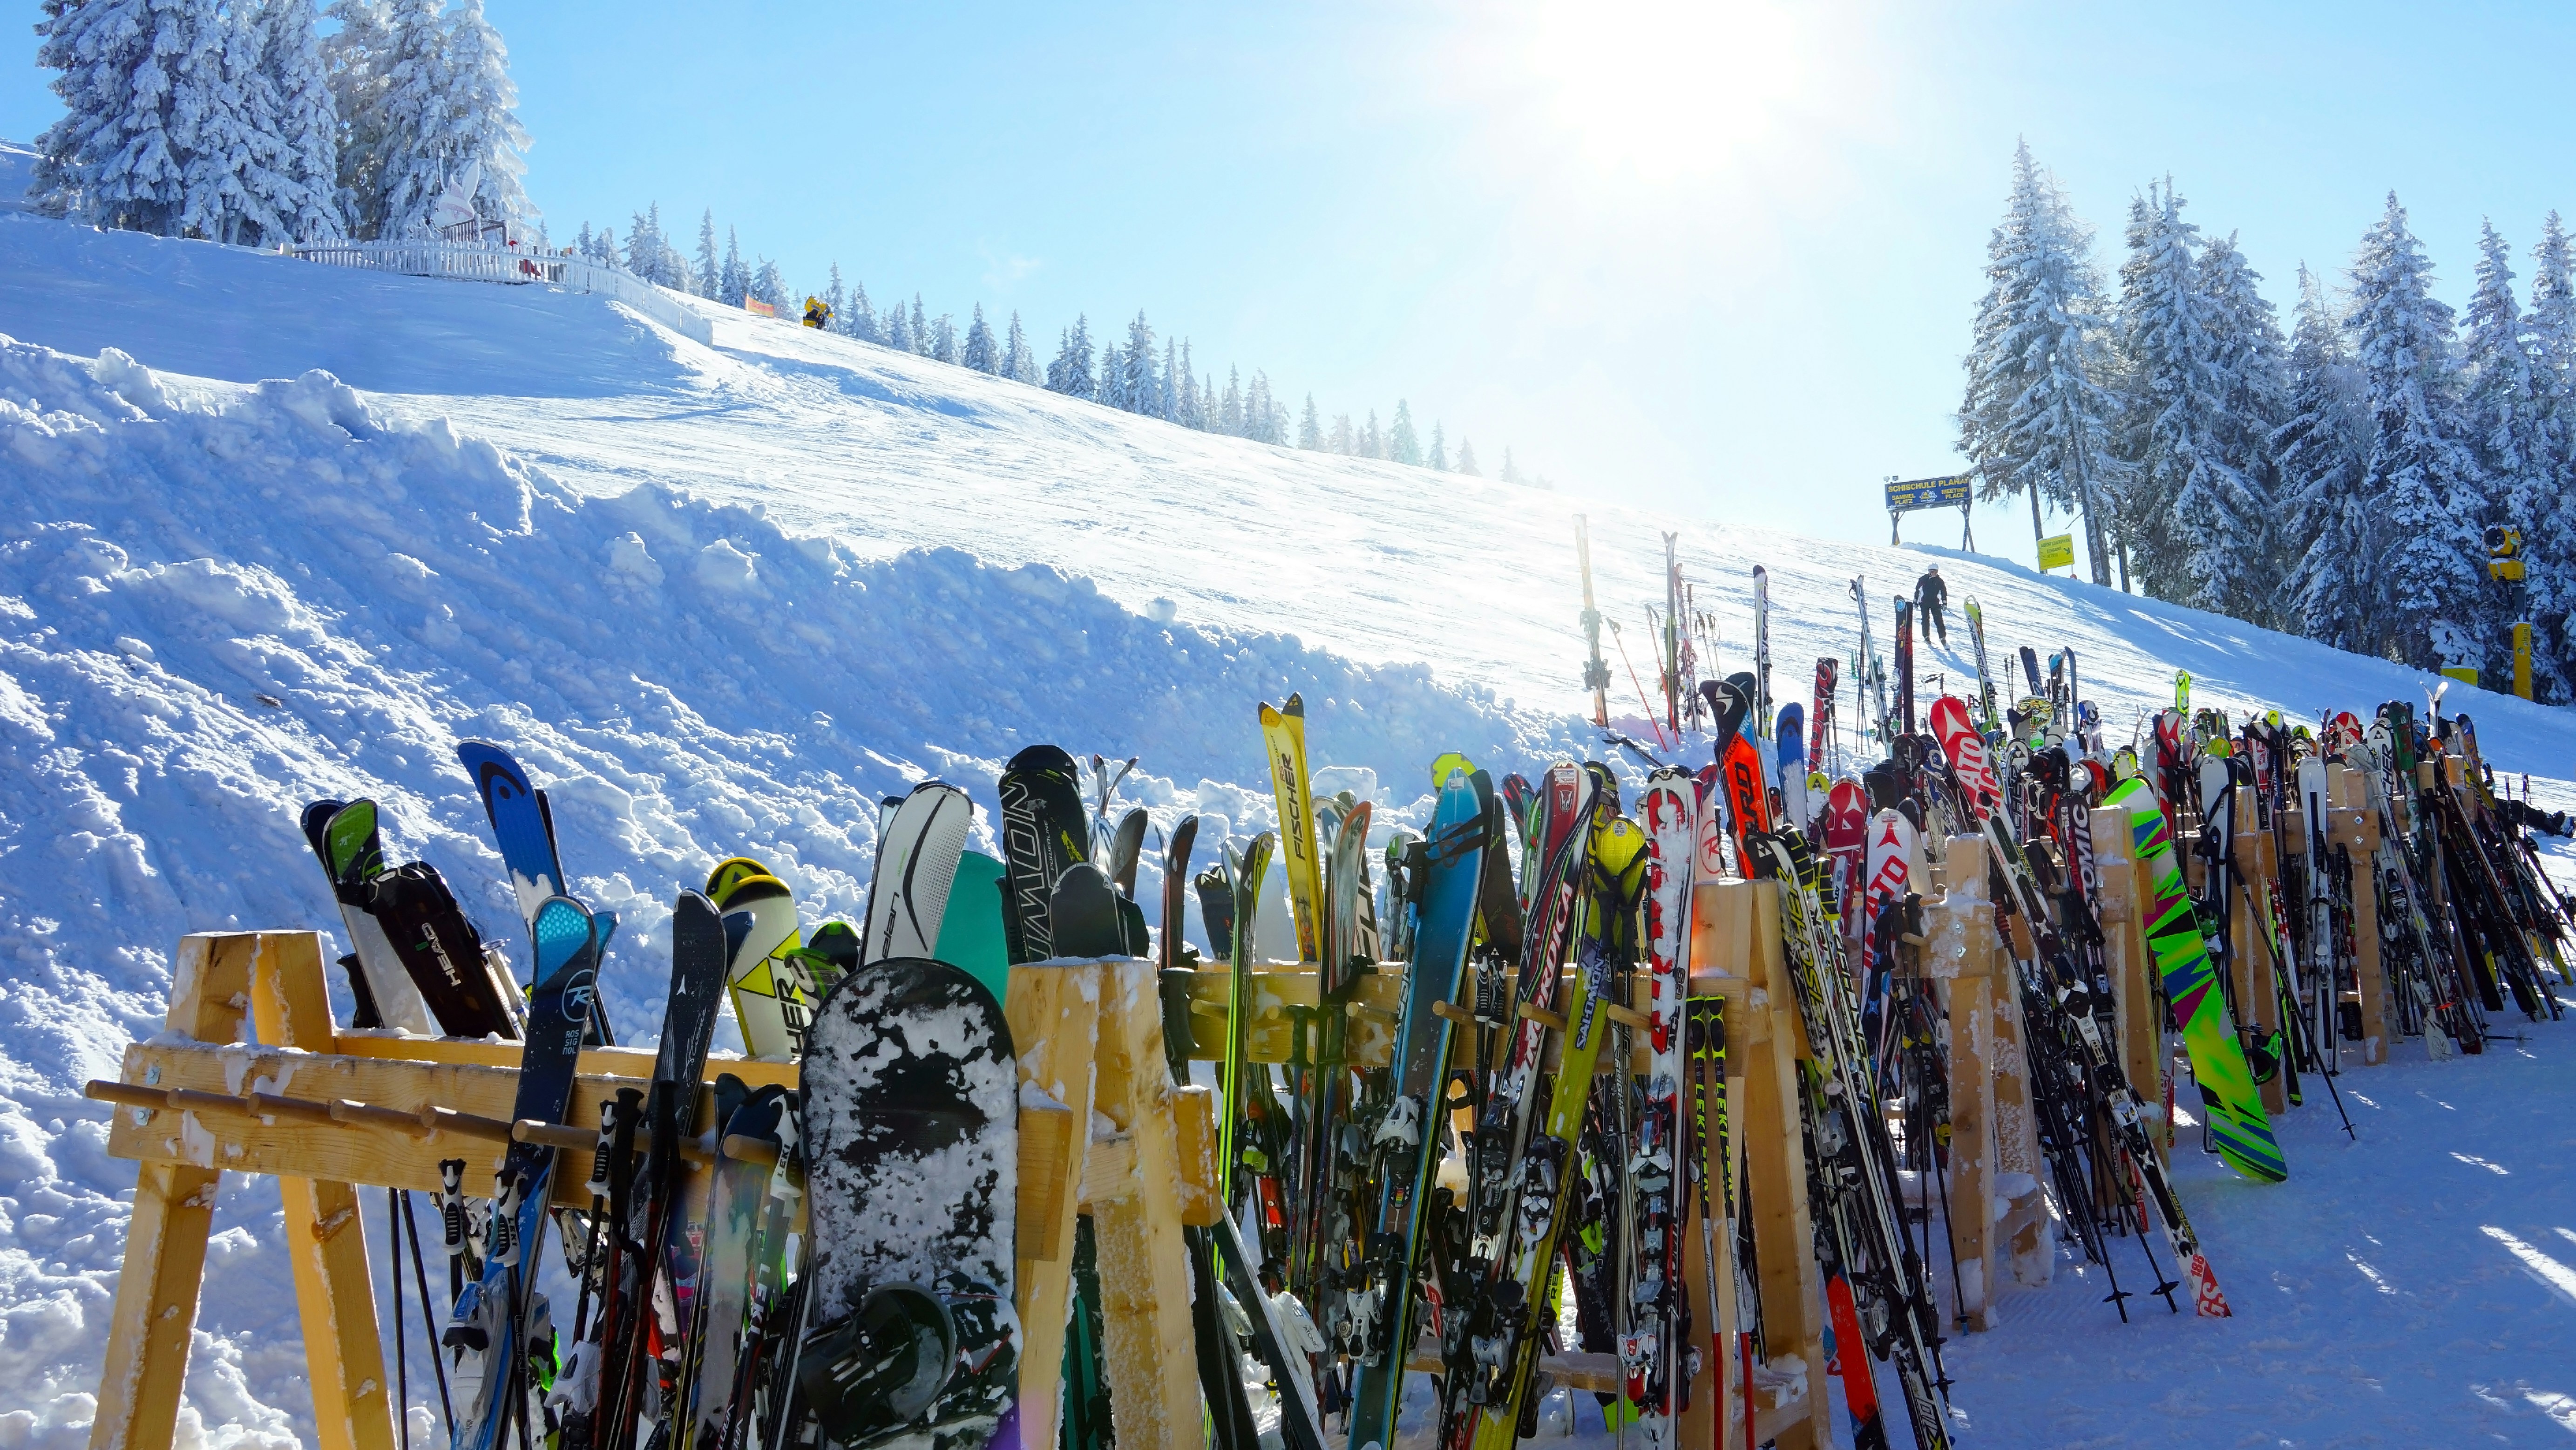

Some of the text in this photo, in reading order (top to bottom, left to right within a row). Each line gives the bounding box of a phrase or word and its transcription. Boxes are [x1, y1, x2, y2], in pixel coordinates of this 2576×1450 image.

[1888, 481, 1936, 492] SCHISCHULE
[1725, 734, 1742, 762] RACING
[1738, 714, 1751, 735] WRC
[1956, 737, 1982, 792] ATO
[1281, 753, 1305, 860] FISCHER
[1044, 820, 1055, 872] POWERLINE
[882, 892, 900, 959] elan
[421, 922, 461, 987] HEAD
[1526, 881, 1573, 1071] NORDICA
[1575, 957, 1606, 1050] SALOMON
[1676, 967, 1686, 1000] GS
[564, 1037, 578, 1046] SIG
[565, 1029, 579, 1038] ROS
[778, 976, 806, 1058] HER
[1615, 1057, 1625, 1116] FLIGHT
[1695, 1084, 1706, 1138] LEKI
[1716, 1082, 1728, 1137] LEKI
[777, 1143, 790, 1178] LEKI
[508, 1217, 518, 1246] LEKI
[1550, 1253, 1561, 1300] REBE
[1731, 1253, 1740, 1293] RACING
[2190, 1253, 2206, 1278] 188
[749, 1262, 771, 1334] LEKI
[2199, 1281, 2226, 1318] GS
[515, 1314, 527, 1373] LEKI
[1302, 1325, 1320, 1349] ATOMIC
